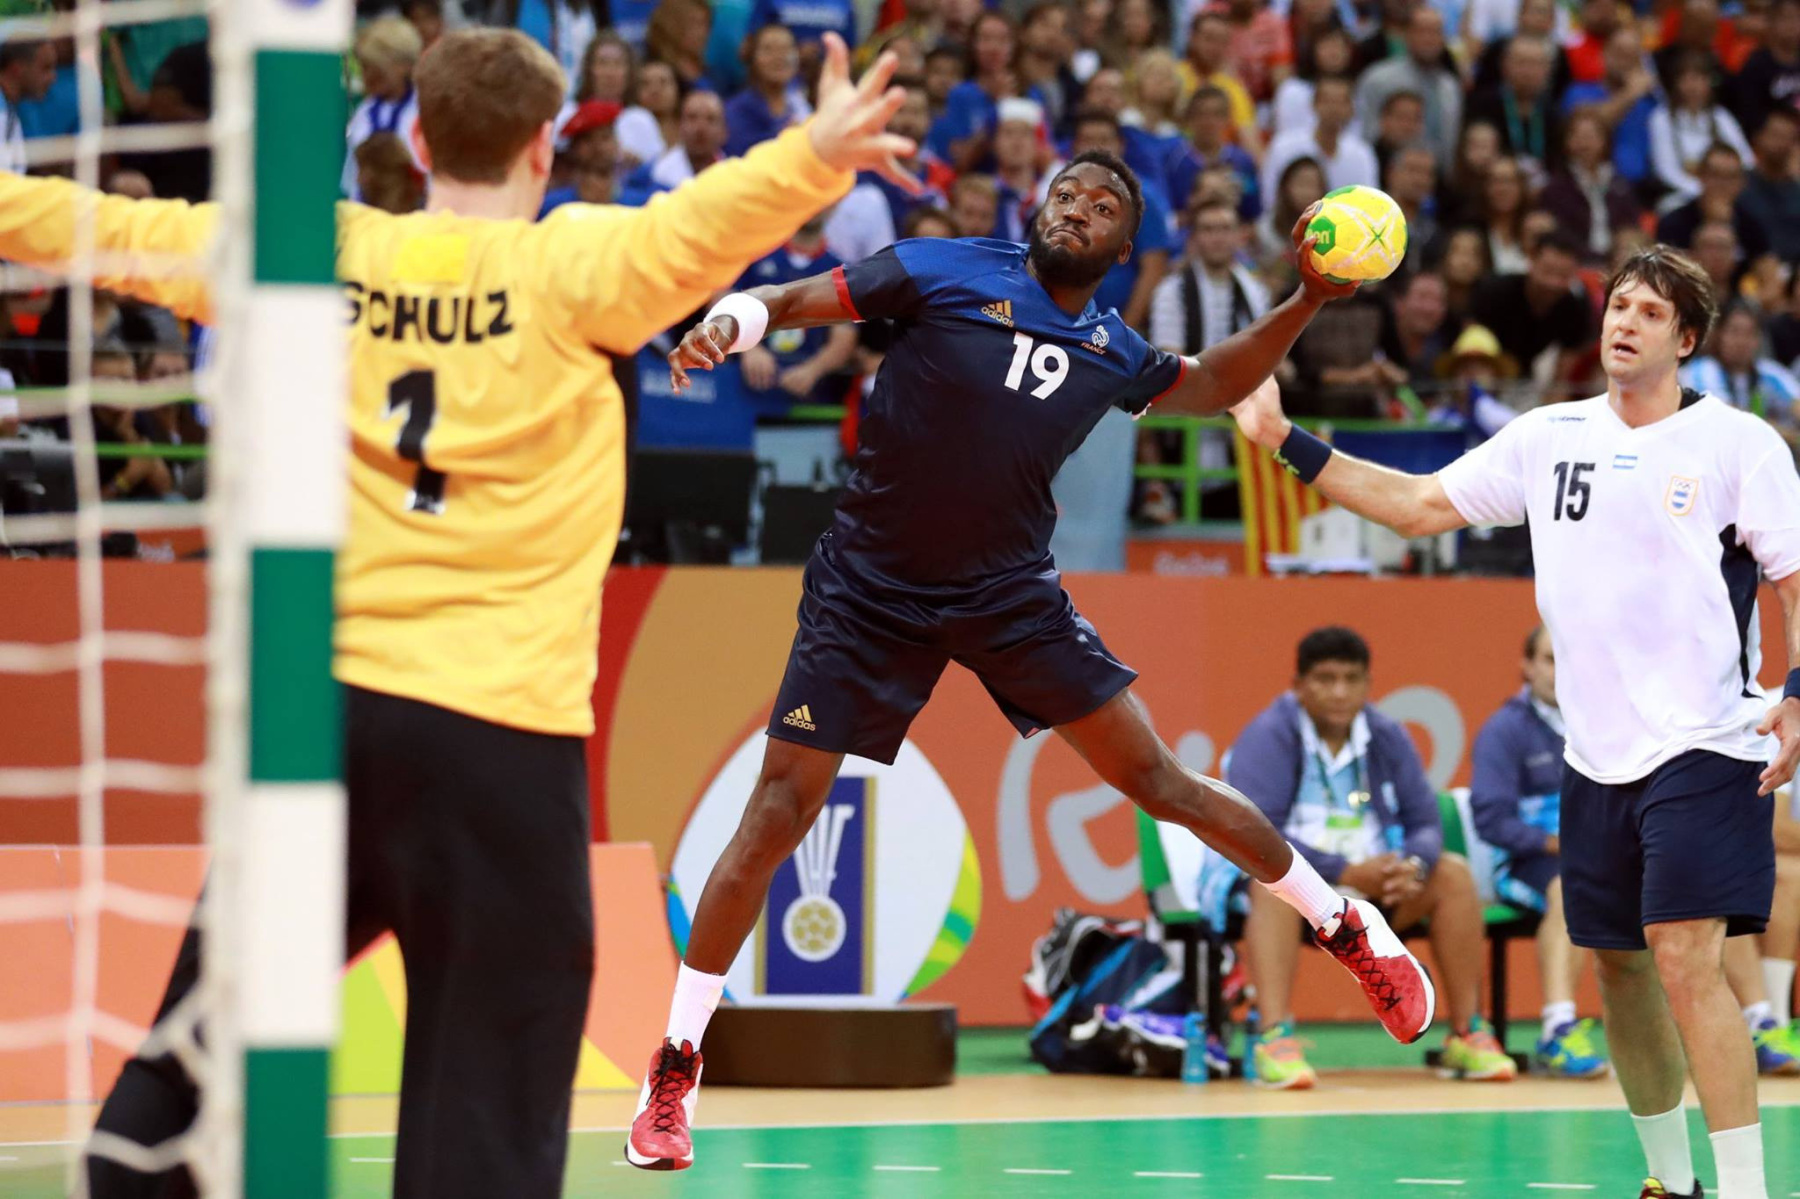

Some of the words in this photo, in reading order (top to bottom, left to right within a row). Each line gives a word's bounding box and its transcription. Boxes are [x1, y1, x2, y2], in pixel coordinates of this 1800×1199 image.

[342, 281, 514, 344] SCHULZ
[981, 306, 1015, 328] adidas
[1004, 331, 1070, 400] 19
[384, 368, 449, 516] 1
[1553, 461, 1596, 522] 15
[782, 715, 816, 732] adidas
